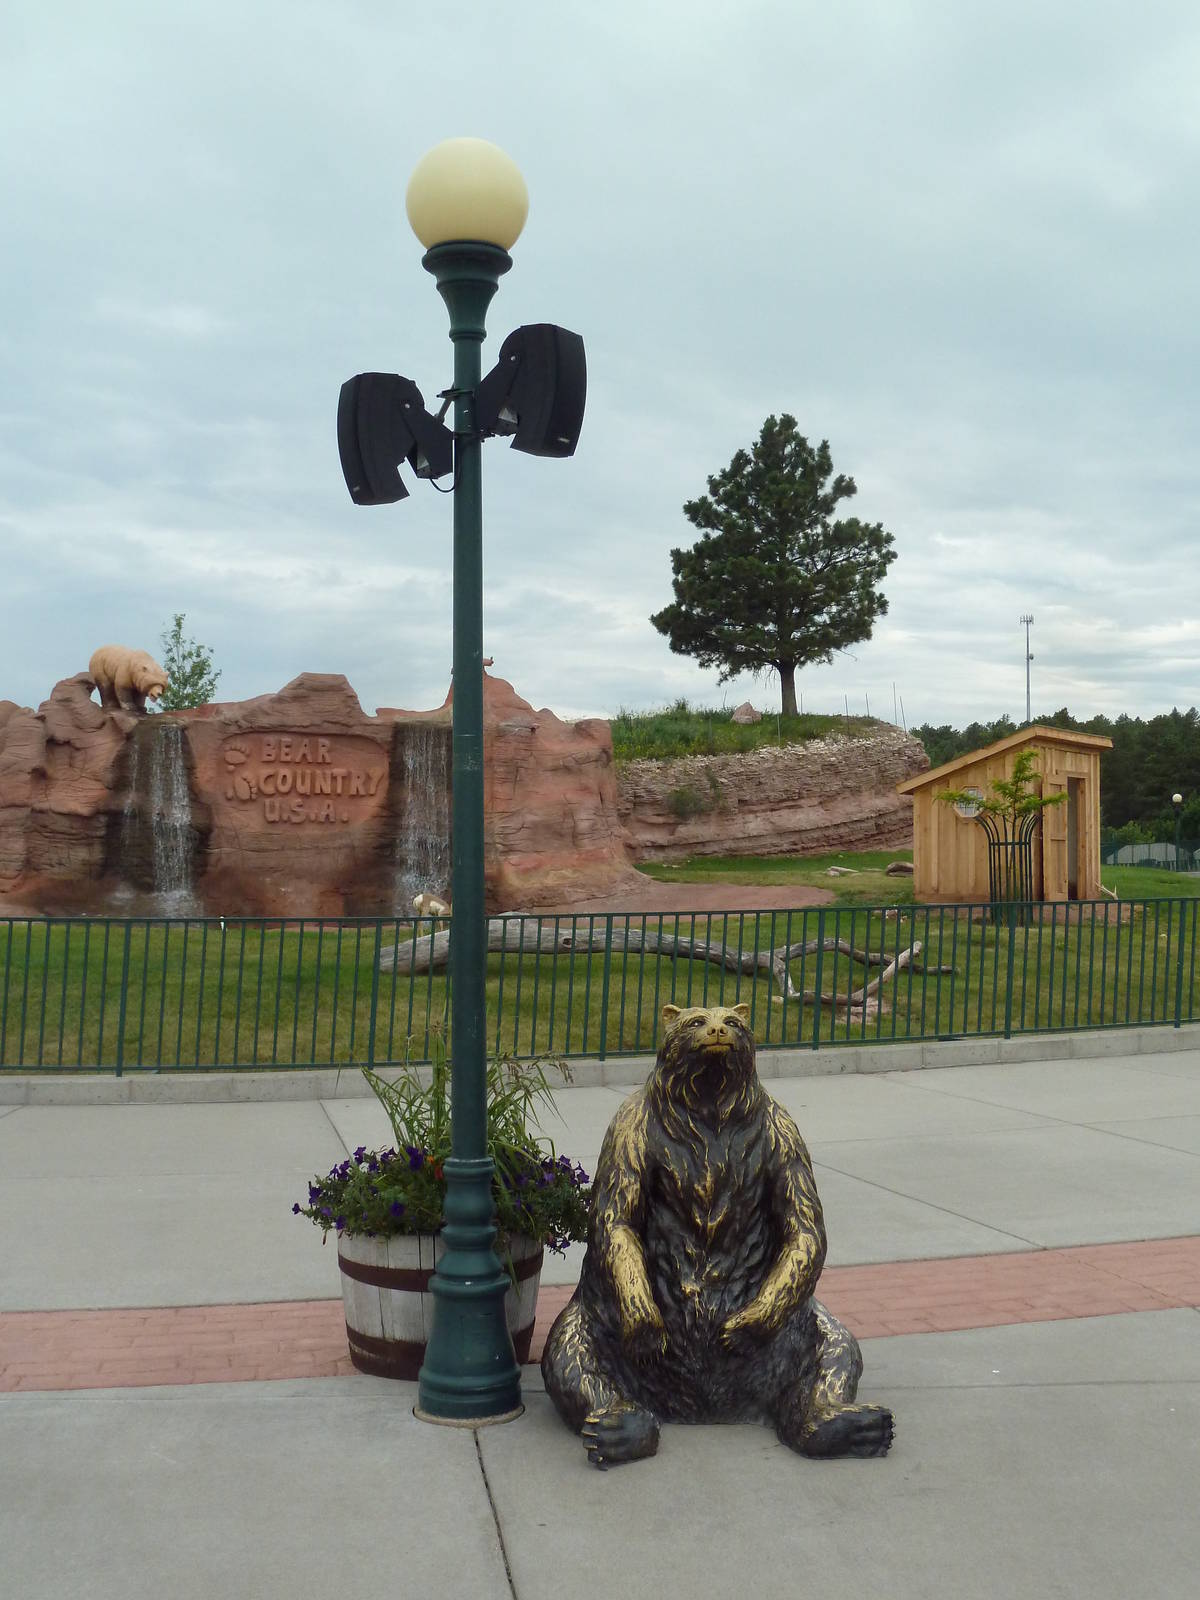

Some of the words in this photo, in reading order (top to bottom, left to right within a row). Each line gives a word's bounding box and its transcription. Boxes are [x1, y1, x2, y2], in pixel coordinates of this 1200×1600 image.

[261, 737, 332, 763] BEAR
[258, 768, 384, 796] COUNTRY
[264, 799, 349, 823] U.S.A.
